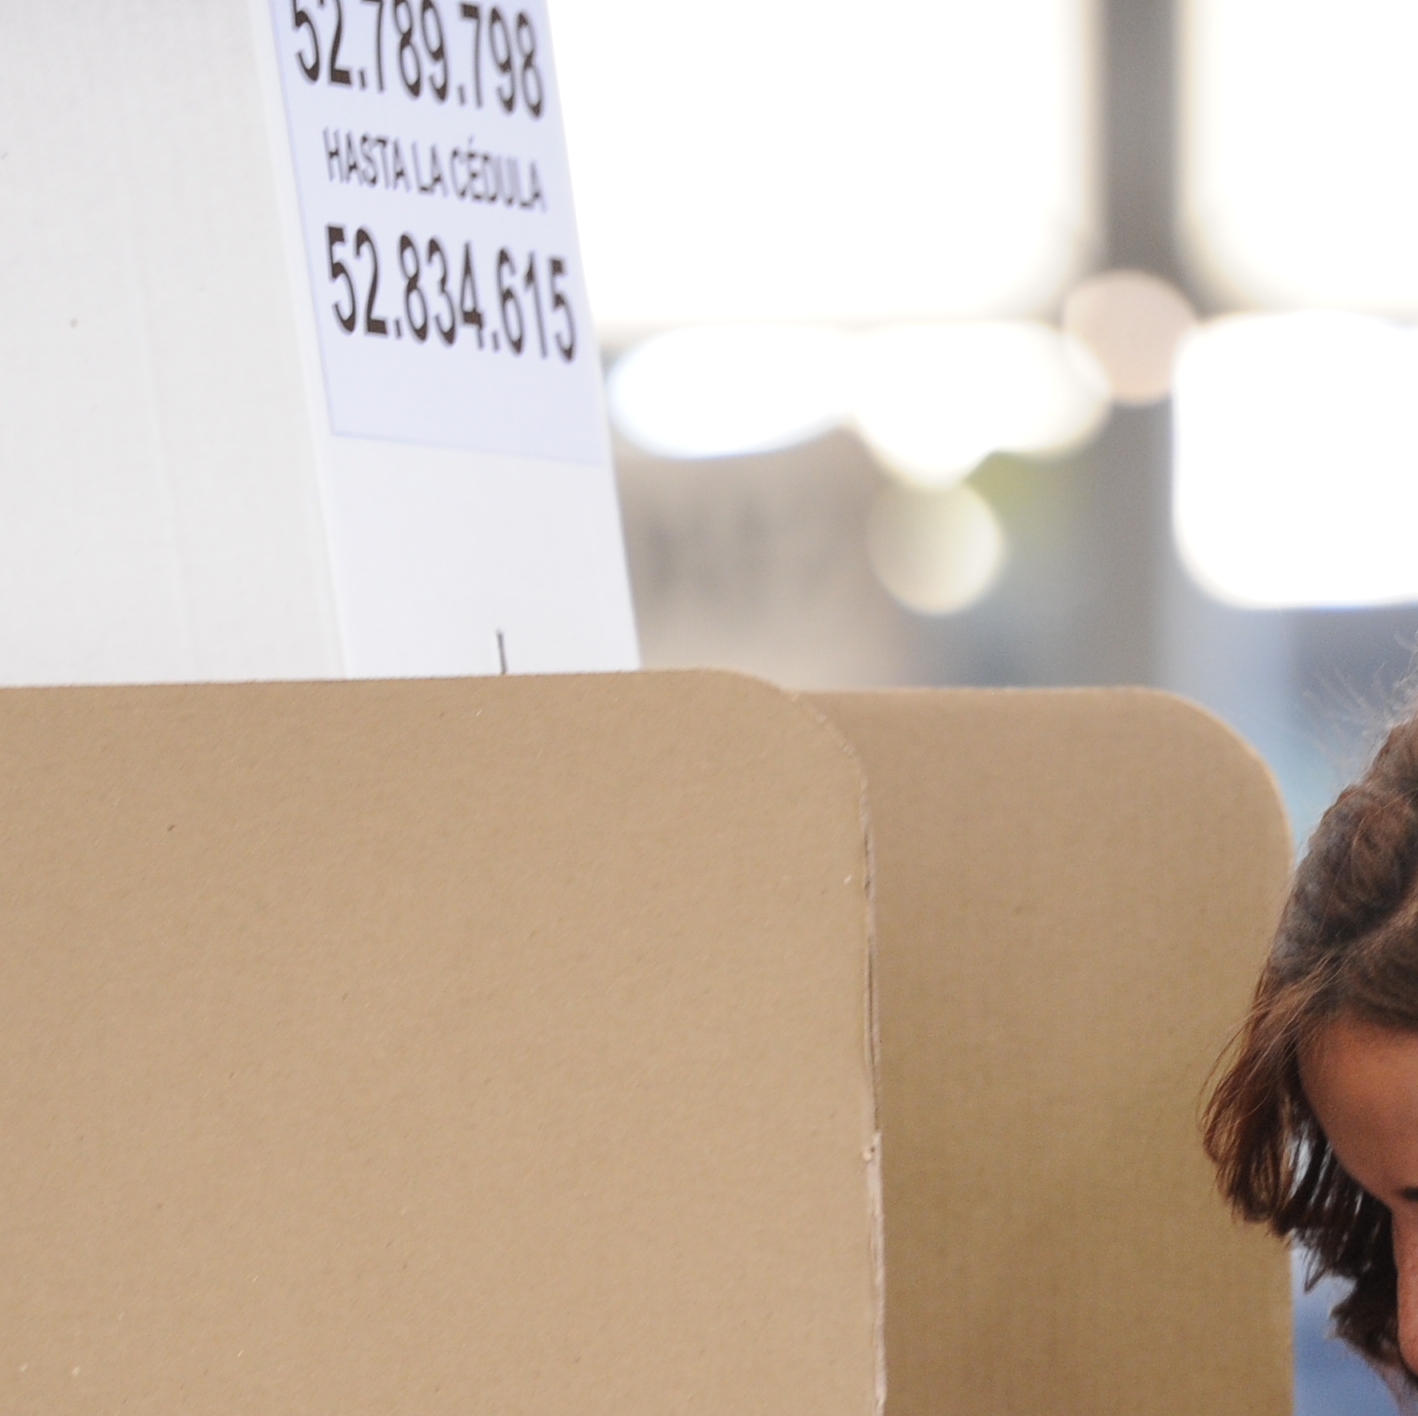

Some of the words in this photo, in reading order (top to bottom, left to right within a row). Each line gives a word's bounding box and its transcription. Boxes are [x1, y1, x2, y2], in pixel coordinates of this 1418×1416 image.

[292, 0, 544, 118] 52.789.798
[323, 127, 411, 192] HASTA
[412, 142, 448, 197] LA
[450, 135, 547, 212] CÉDULA
[326, 224, 576, 363] 52.834.615
